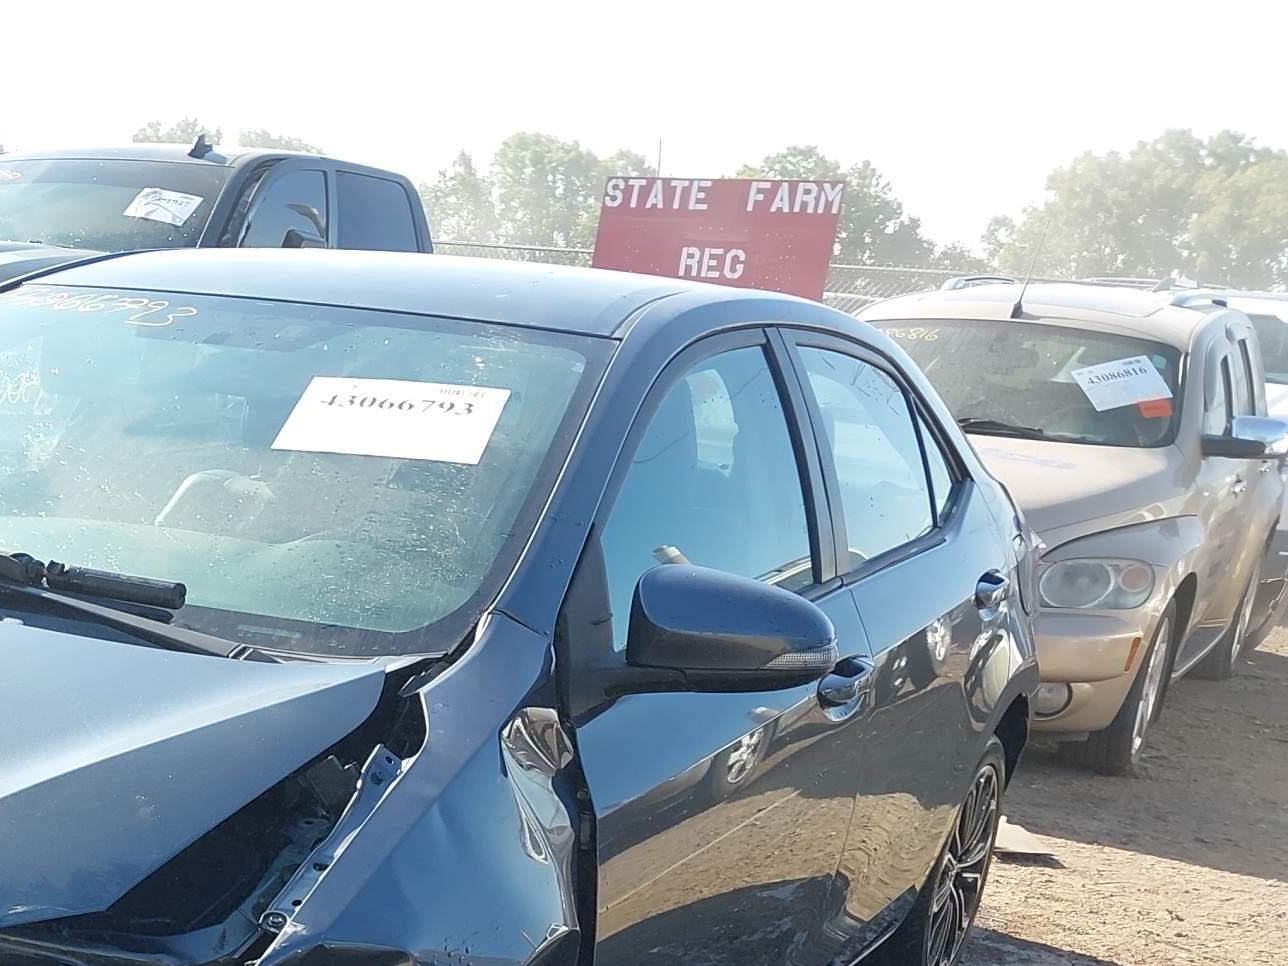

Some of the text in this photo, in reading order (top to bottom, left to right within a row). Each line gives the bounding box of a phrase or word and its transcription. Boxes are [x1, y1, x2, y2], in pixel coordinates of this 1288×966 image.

[604, 178, 845, 214] STATE FARM
[678, 246, 746, 279] REG
[1087, 366, 1149, 386] 43086816
[319, 392, 476, 416] 43066793
